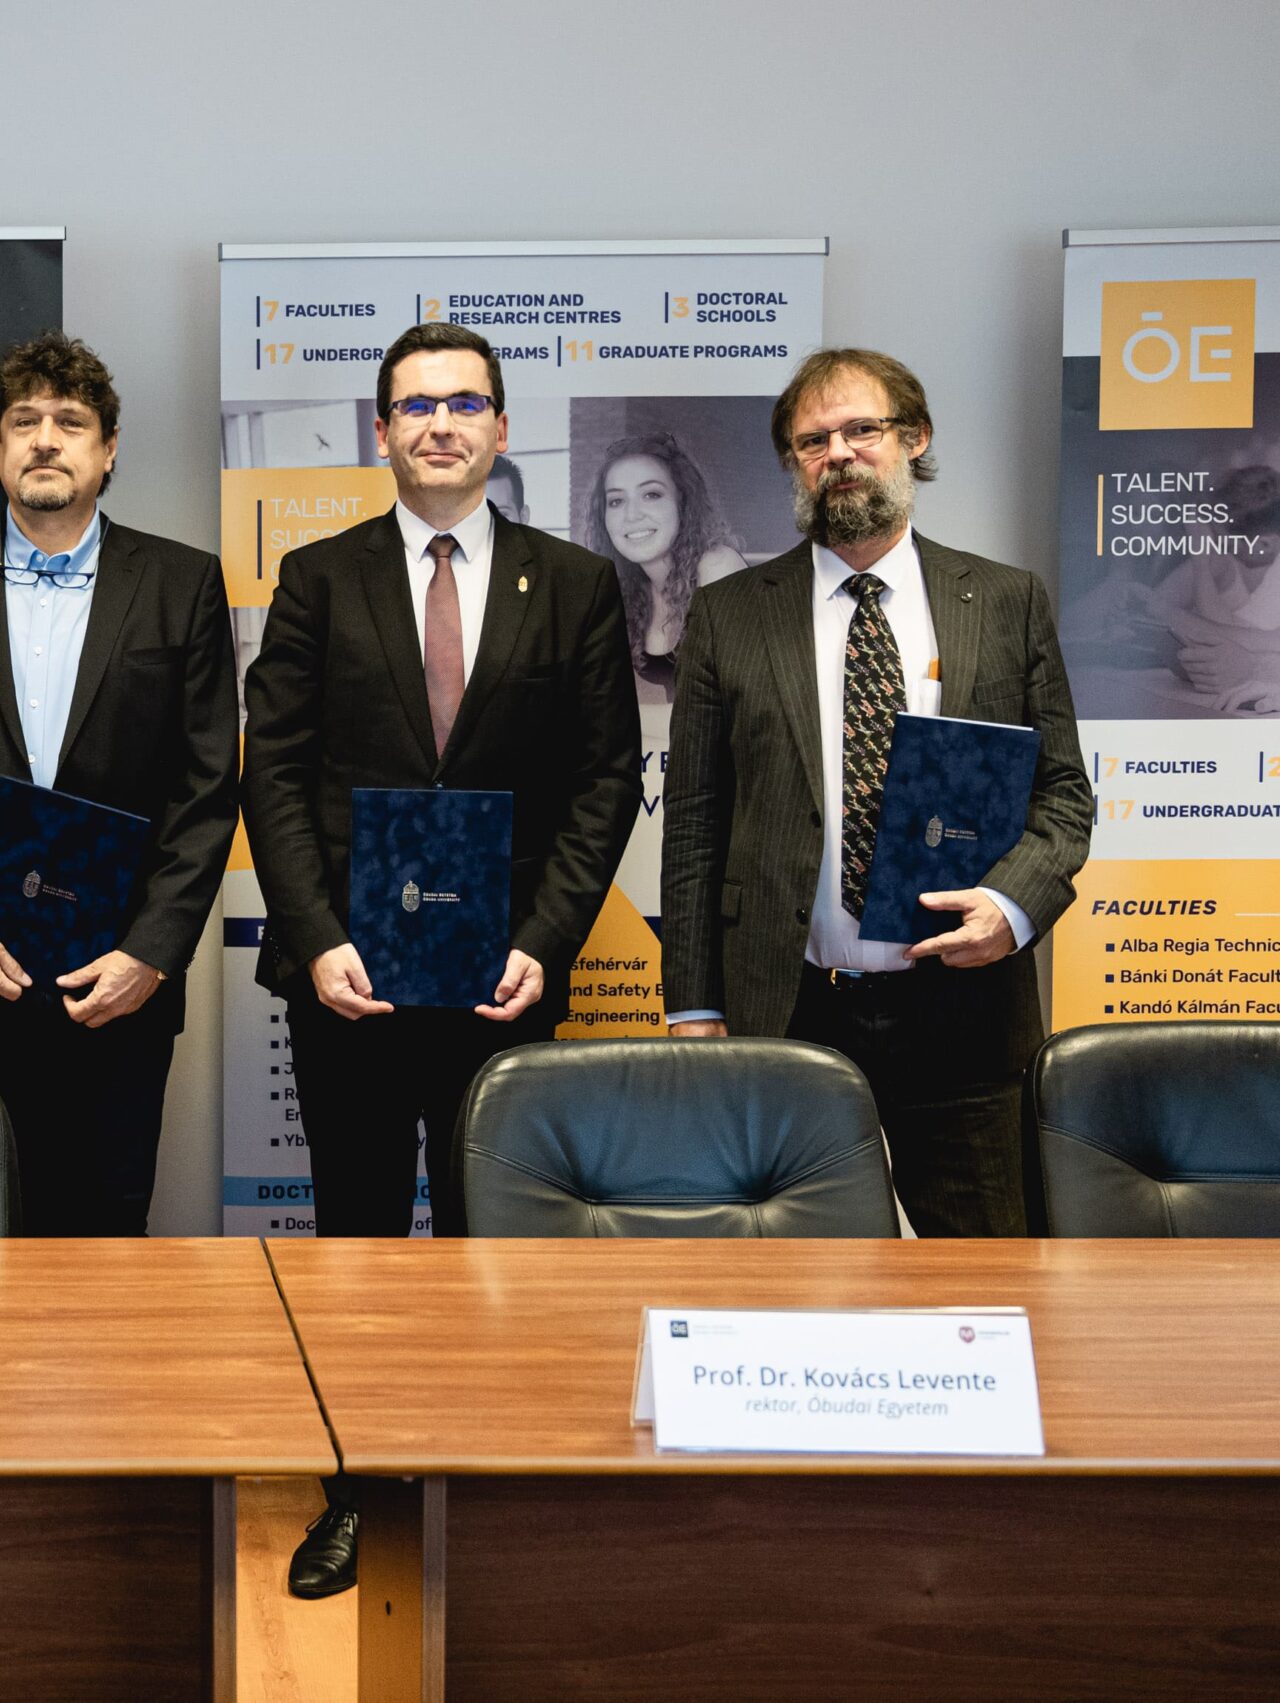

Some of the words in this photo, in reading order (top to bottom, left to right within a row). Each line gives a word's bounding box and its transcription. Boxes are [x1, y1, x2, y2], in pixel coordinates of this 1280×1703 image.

[264, 301, 279, 321] 7
[285, 304, 376, 318] FACULTIES
[424, 298, 441, 320] 2
[449, 294, 545, 308] EDUCATION
[548, 293, 584, 307] AND
[672, 297, 690, 318] 3
[697, 292, 788, 306] DOCTORAL
[449, 311, 539, 325] RESEARCH
[543, 310, 621, 324] CENTRES
[696, 309, 776, 323] SCHOOLS
[264, 343, 295, 364] 17
[303, 347, 385, 362] UNDERGR
[490, 346, 550, 360] GRAMS
[565, 340, 594, 362] 11
[599, 345, 689, 360] GRADUATE
[693, 344, 788, 358] PROGRAMS
[1111, 471, 1214, 494] TALENT.
[271, 497, 368, 518] TALENT.
[1111, 503, 1234, 525] SUCCESS.
[1111, 534, 1264, 557] COMMUNITY.
[1103, 757, 1119, 778] 7
[1125, 761, 1217, 774] FACULTIES
[1103, 800, 1135, 821] 17
[1143, 804, 1280, 818] UNDERGRADUAT
[1091, 899, 1217, 916] FACULTIES
[1120, 938, 1159, 953] Alba
[1163, 938, 1210, 956] Regia
[1214, 938, 1280, 952] Technic
[570, 957, 648, 971] sfehérvár
[1120, 969, 1168, 984] Bánki
[1172, 969, 1223, 983] Donát
[1229, 969, 1280, 983] Facult
[597, 983, 651, 999] Safety
[1120, 1000, 1171, 1015] Kandó
[1177, 999, 1240, 1014] Kálmán
[258, 1184, 313, 1199] DOCT
[693, 1365, 751, 1387] Prof.
[760, 1366, 796, 1388] Dr.
[804, 1367, 890, 1390] Kovács
[898, 1369, 996, 1391] Levente
[745, 1397, 801, 1415] rektor,
[877, 1398, 949, 1420] Egyetem
